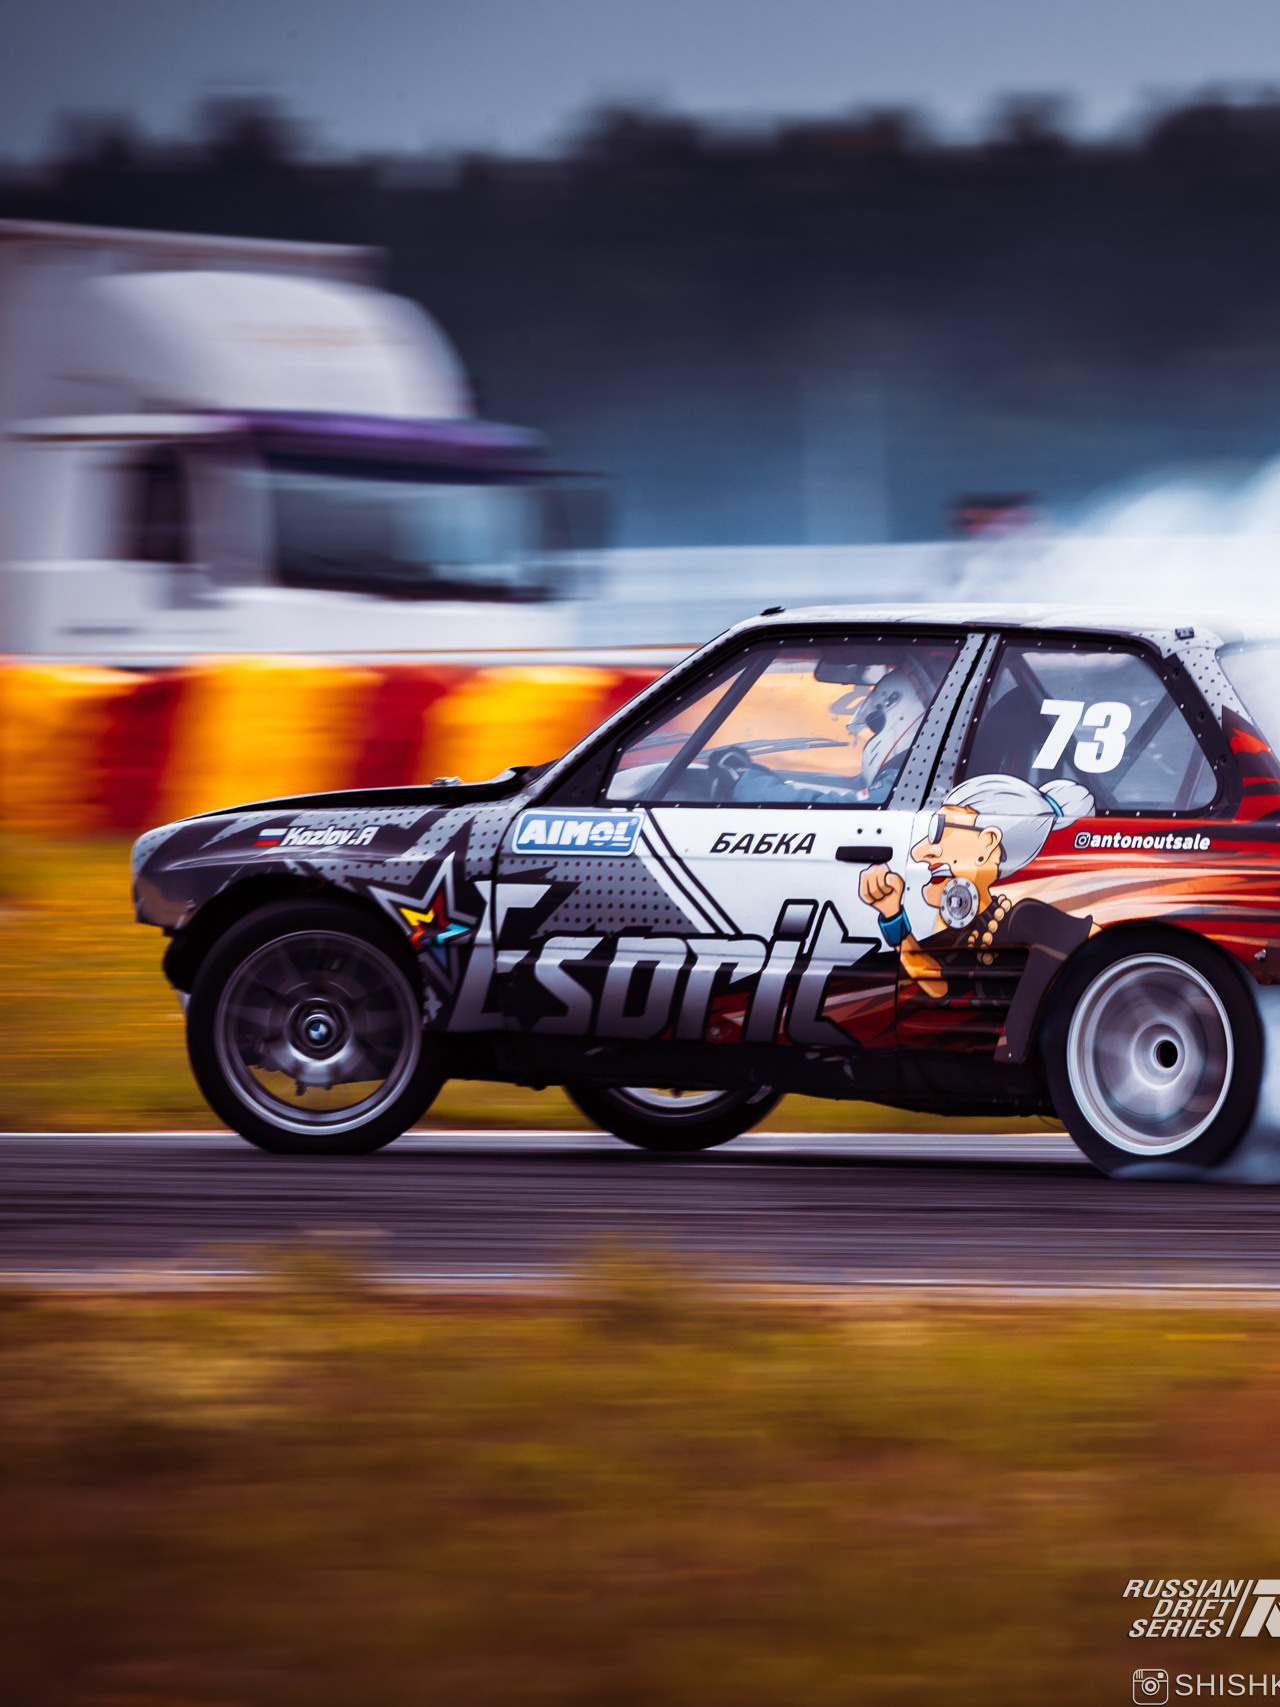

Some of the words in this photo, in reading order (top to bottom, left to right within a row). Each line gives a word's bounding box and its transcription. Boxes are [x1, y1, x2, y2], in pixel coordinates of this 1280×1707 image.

[1031, 698, 1132, 774] 73
[517, 819, 633, 847] AIMOL
[709, 832, 816, 854] БАБКА
[1090, 832, 1211, 850] antonoutsale
